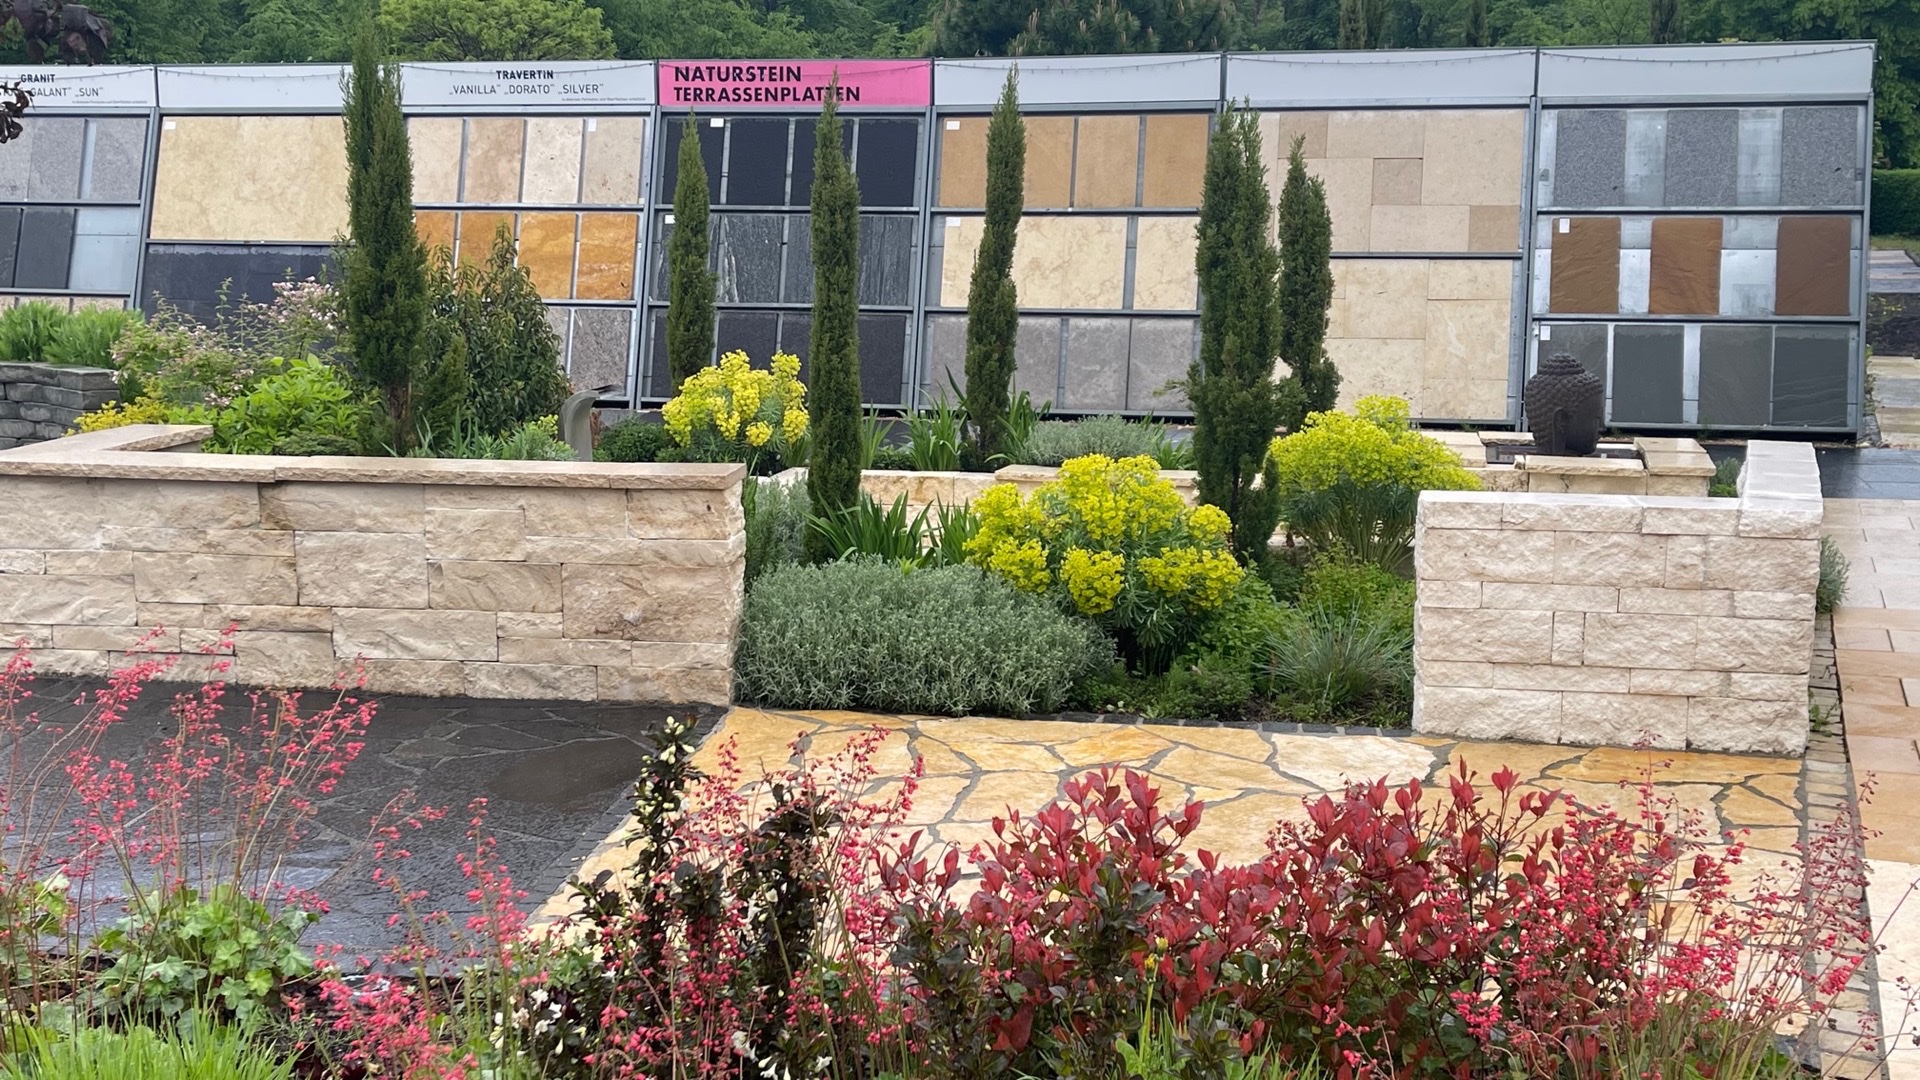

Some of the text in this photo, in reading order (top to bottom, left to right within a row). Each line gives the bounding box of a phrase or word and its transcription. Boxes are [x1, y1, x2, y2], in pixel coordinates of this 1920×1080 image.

[20, 74, 56, 83] GRANIT
[496, 70, 554, 80] TRAVERTIN
[674, 66, 801, 82] NATURSTEIN
